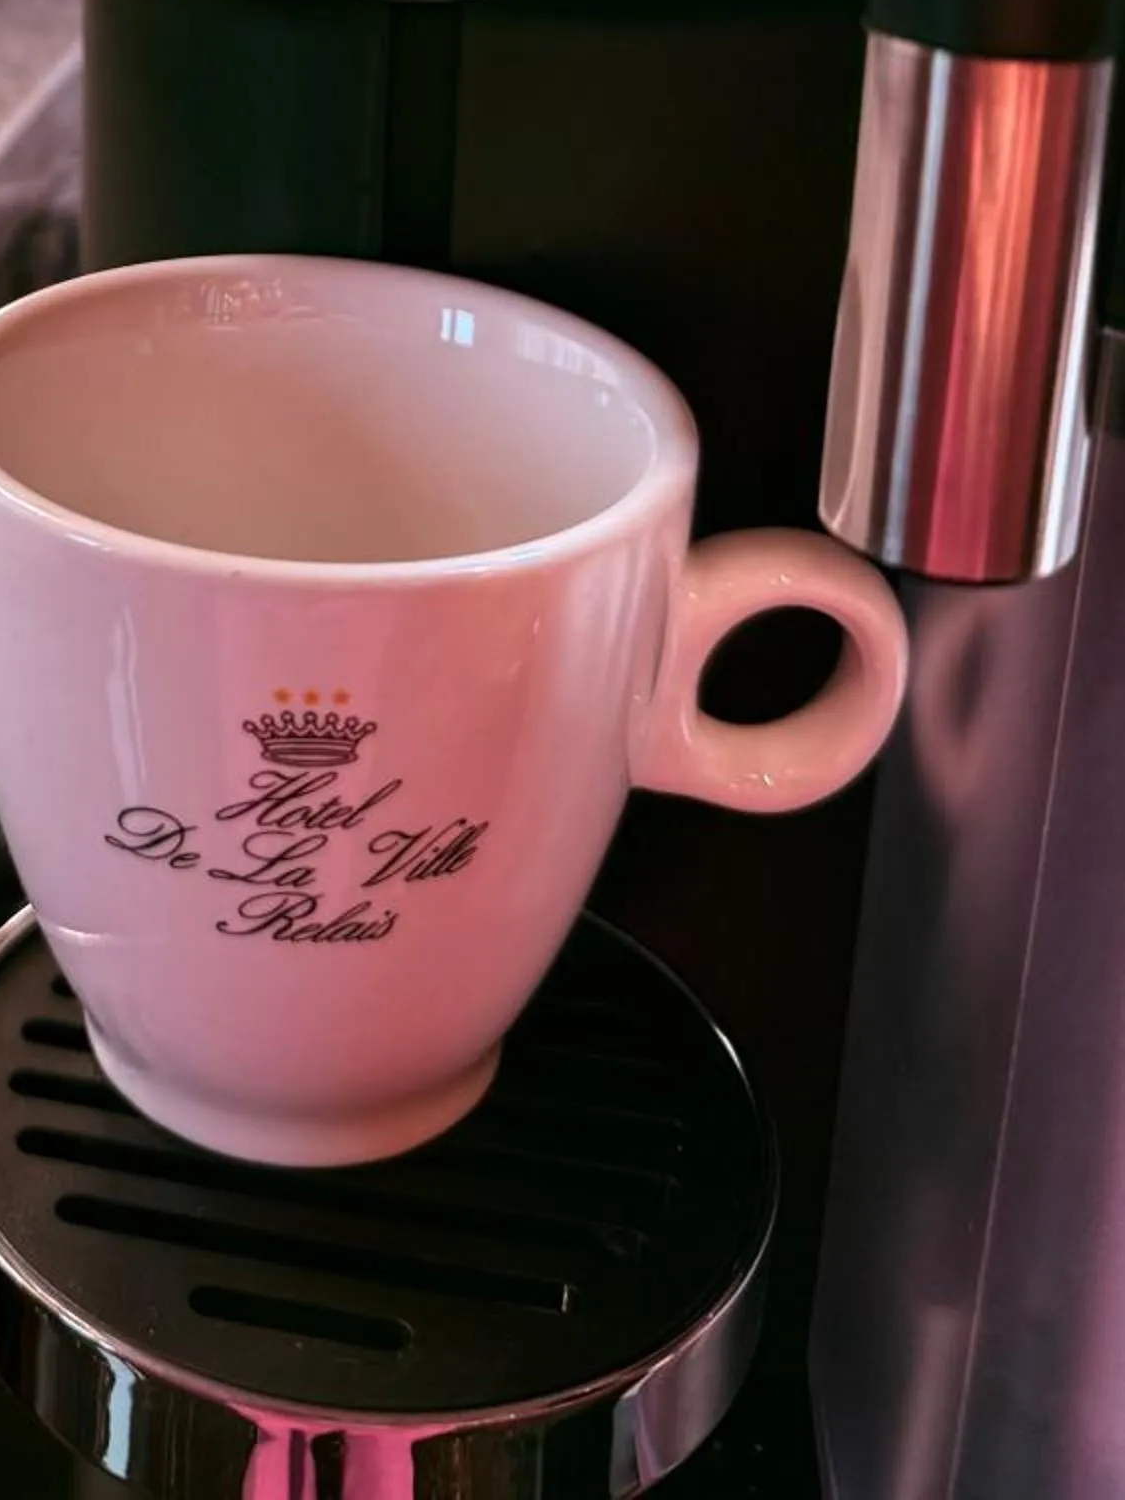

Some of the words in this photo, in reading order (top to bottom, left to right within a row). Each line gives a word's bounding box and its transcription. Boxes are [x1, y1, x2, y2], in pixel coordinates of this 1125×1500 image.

[215, 770, 403, 830] Hotel
[104, 806, 201, 869] De
[207, 830, 328, 887] La
[361, 817, 489, 887] Ville
[215, 891, 398, 943] Relais
